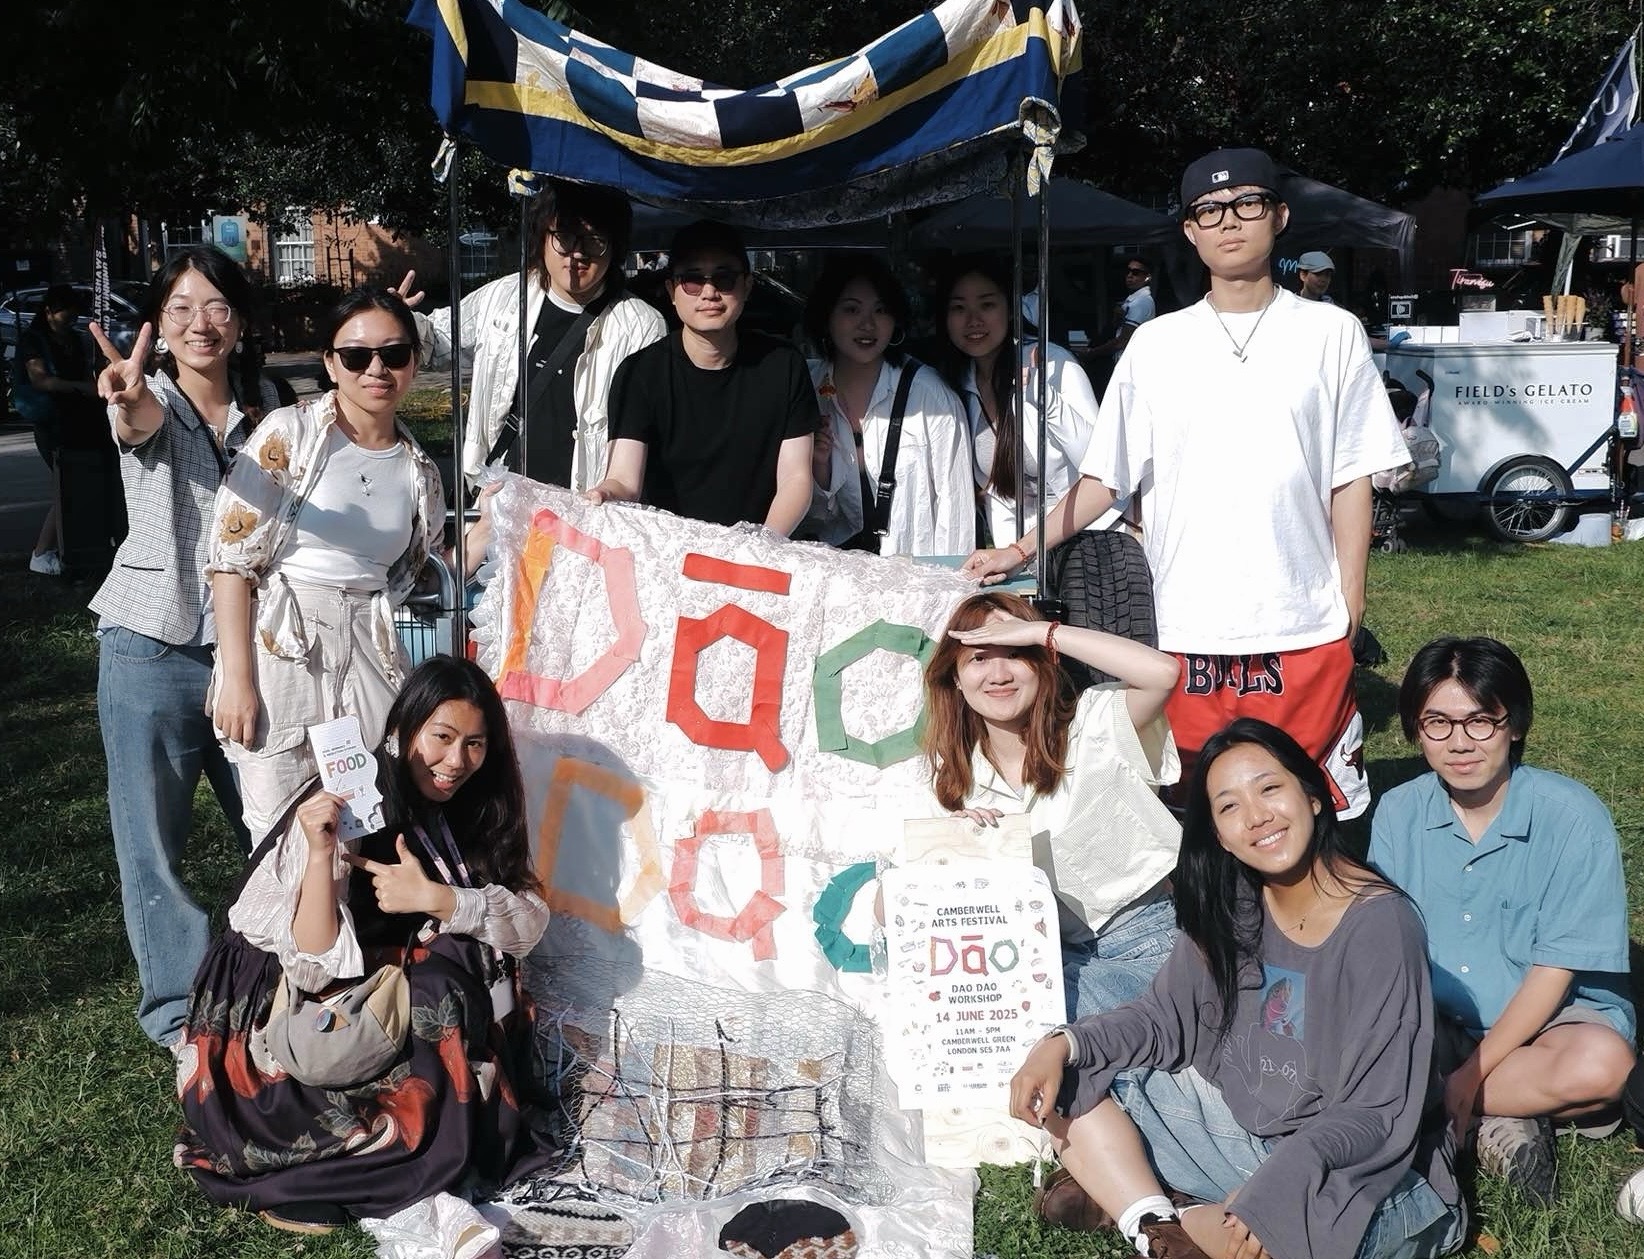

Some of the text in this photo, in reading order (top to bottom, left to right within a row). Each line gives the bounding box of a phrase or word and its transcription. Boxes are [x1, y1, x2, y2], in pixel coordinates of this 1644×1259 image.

[1455, 383, 1593, 398] FIELD's GELATO
[325, 752, 367, 778] FOOD
[937, 904, 1001, 916] CAMBERWELL
[932, 915, 1008, 928] ARTS FESTIVAL
[951, 982, 998, 993] DAO DAO
[948, 993, 1002, 1004] WORKSHOP
[936, 1009, 1018, 1023] 14 JUNE 2025
[955, 1028, 975, 1036] 11AM
[941, 1035, 1016, 1046] CAMBERWELL GREEN
[947, 1047, 977, 1055] LONDON
